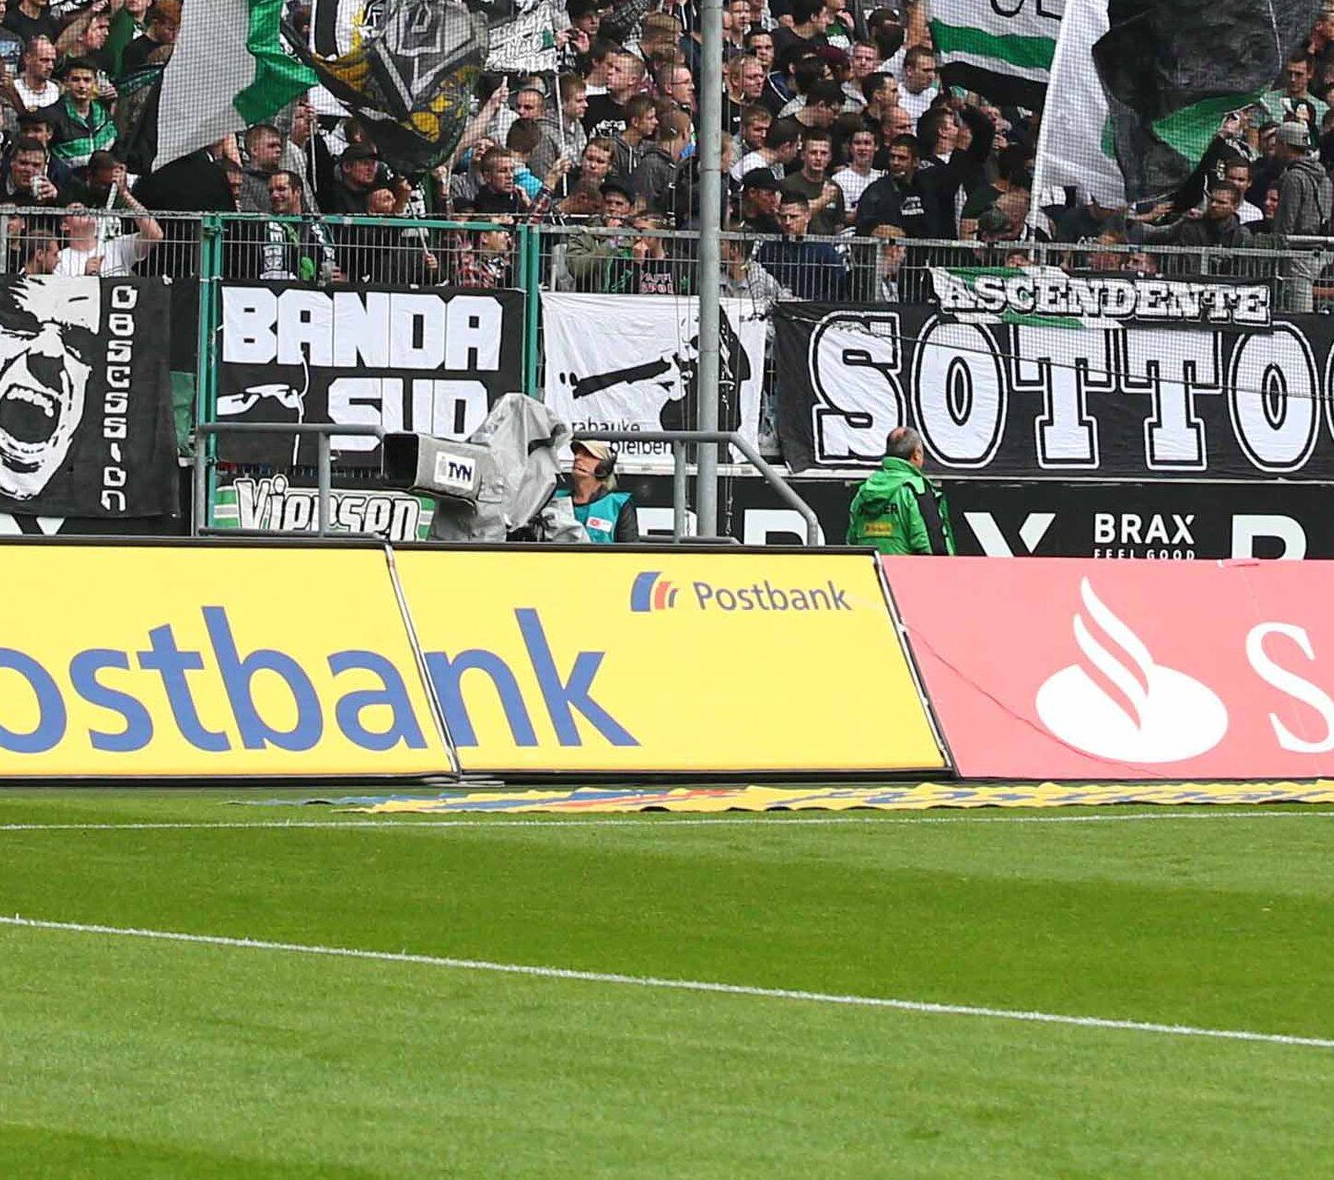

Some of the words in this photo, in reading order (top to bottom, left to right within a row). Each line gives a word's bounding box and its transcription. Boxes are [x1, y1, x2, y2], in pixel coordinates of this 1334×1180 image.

[932, 272, 1272, 326] ASCENDENTE
[221, 286, 503, 372] BANDA
[327, 377, 489, 453] SUD
[1094, 512, 1196, 546] BRAX
[695, 579, 853, 613] Postbank
